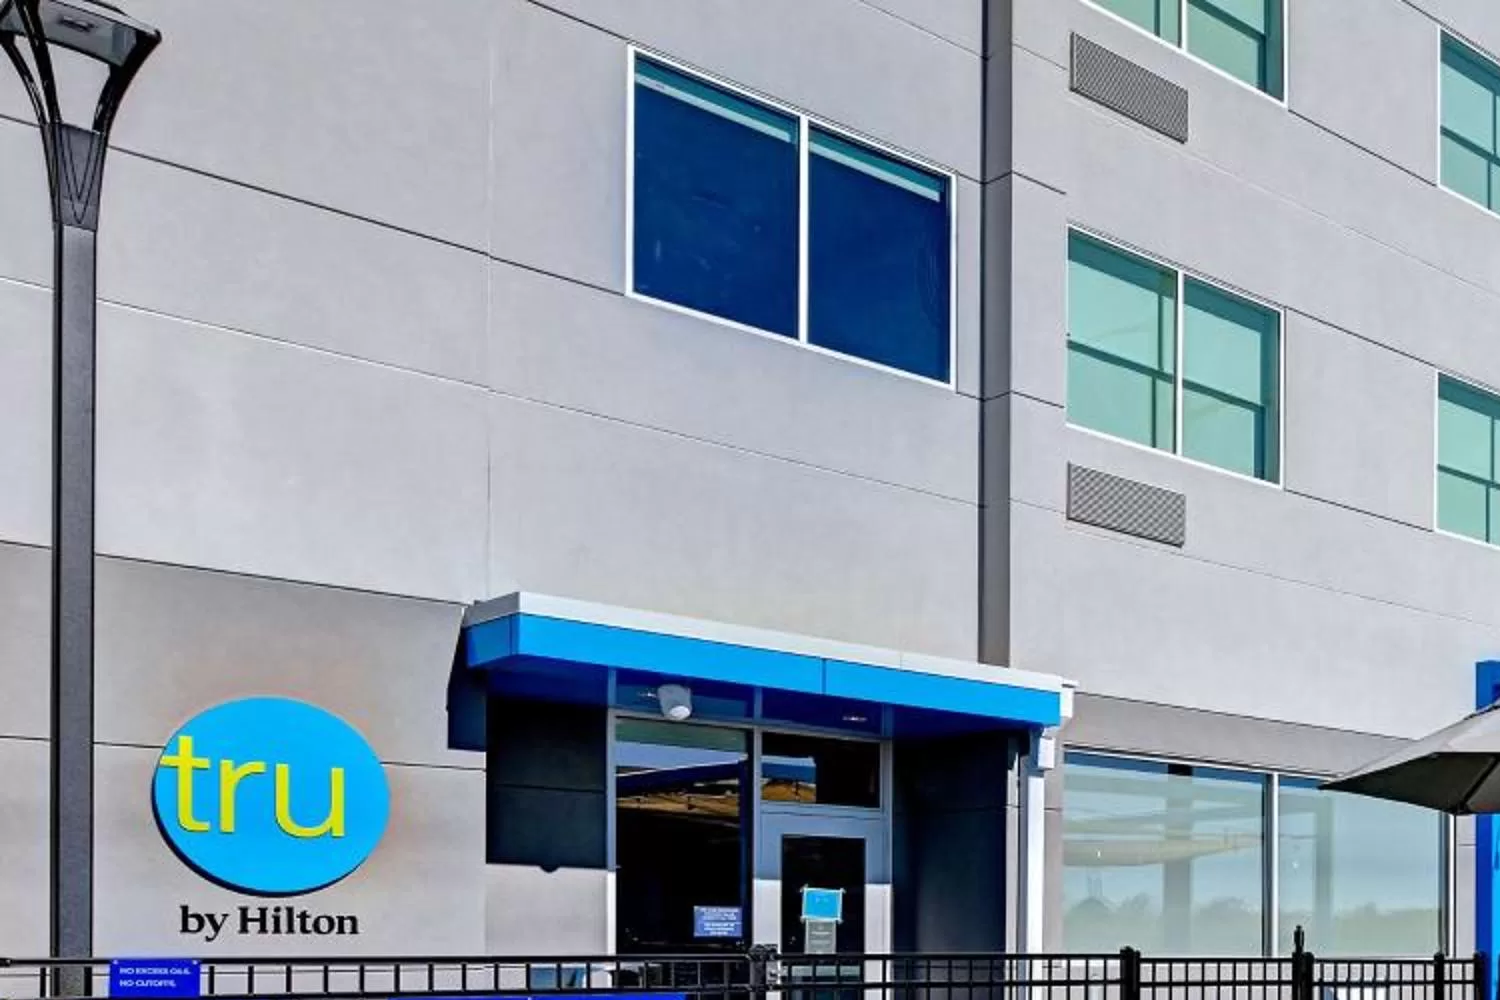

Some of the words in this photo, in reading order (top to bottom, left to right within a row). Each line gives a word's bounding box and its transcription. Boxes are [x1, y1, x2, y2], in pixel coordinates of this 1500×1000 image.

[160, 735, 345, 838] tru
[180, 906, 228, 942] by
[238, 906, 359, 935] Hilton
